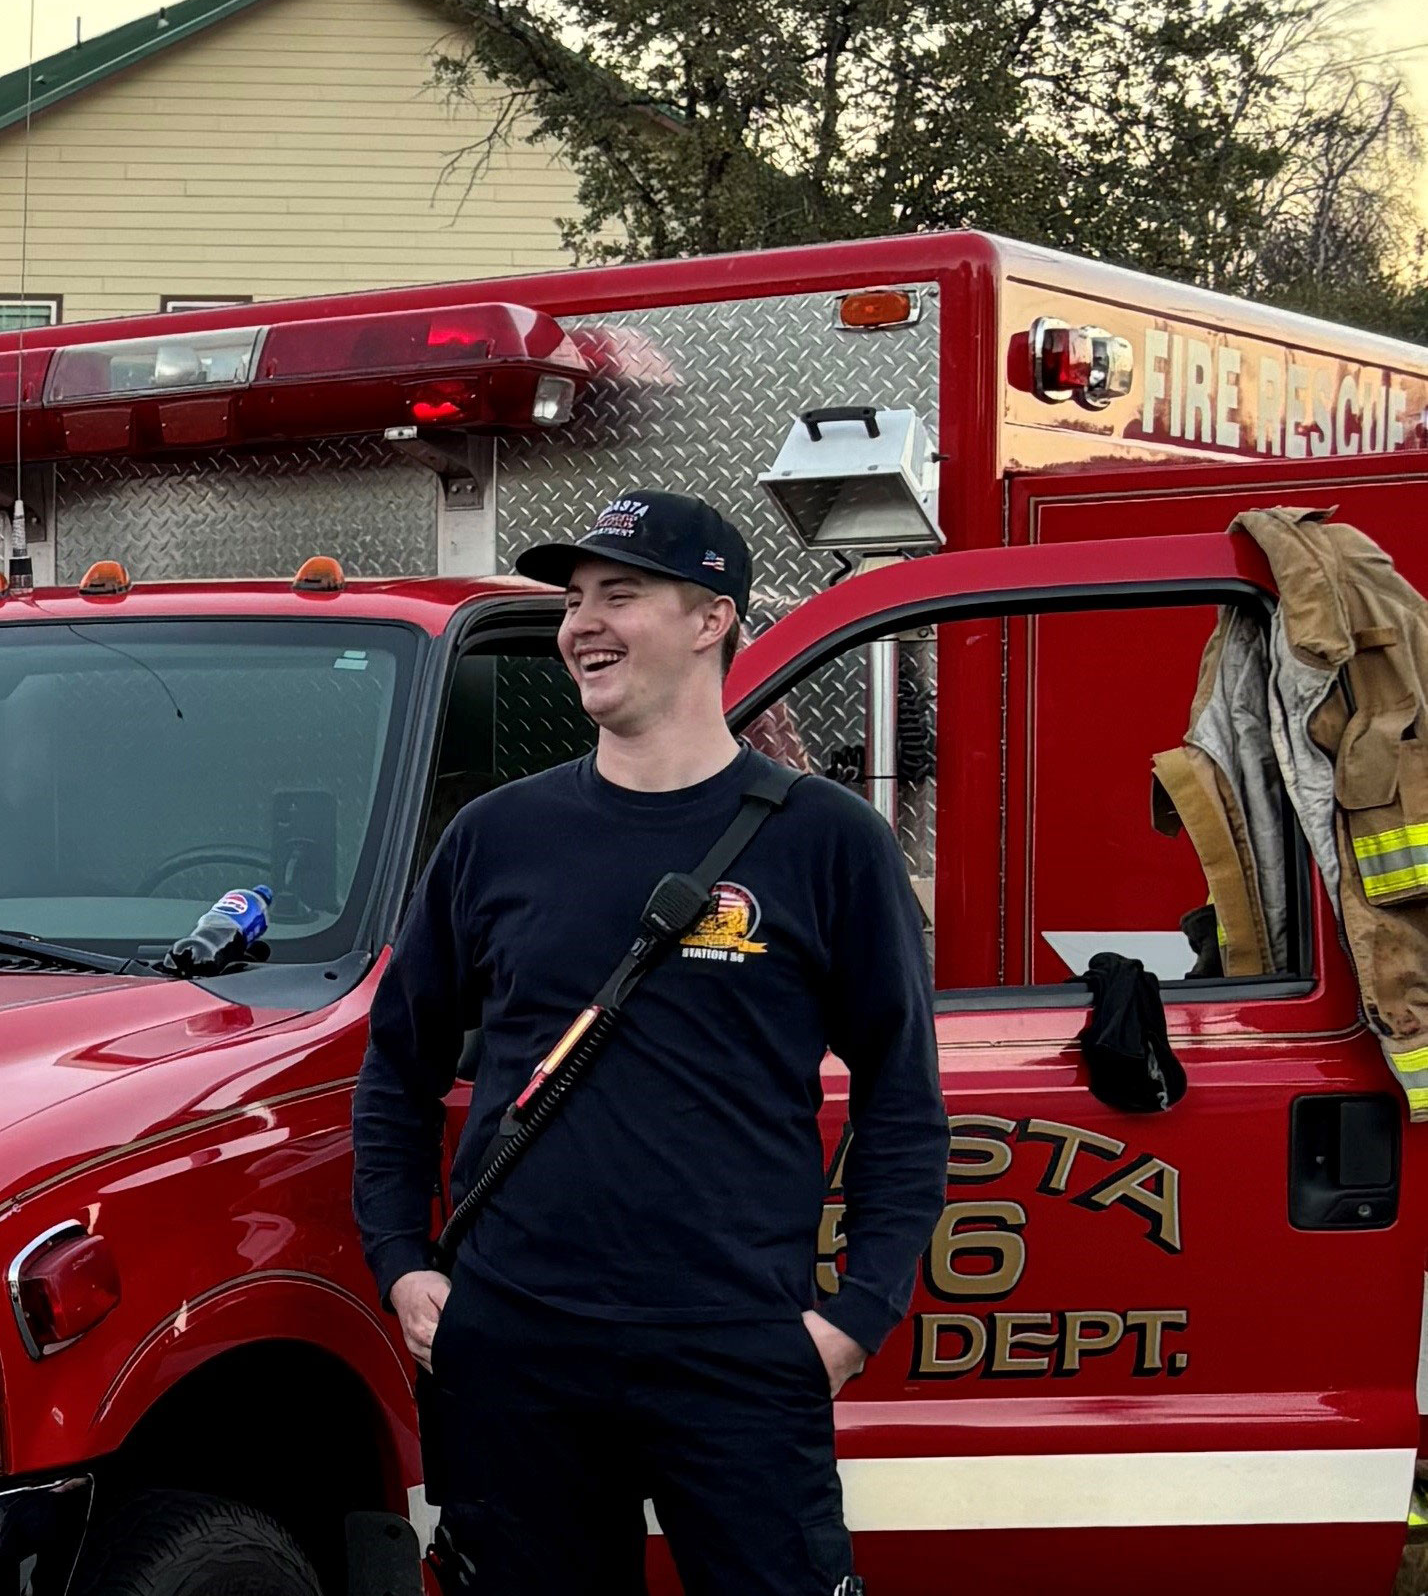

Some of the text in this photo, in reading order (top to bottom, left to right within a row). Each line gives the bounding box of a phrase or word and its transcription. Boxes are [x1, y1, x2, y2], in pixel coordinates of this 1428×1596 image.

[1142, 328, 1406, 459] FIRE RESCUE
[681, 947, 728, 961] STATION
[916, 1310, 1188, 1376] DEPT.
